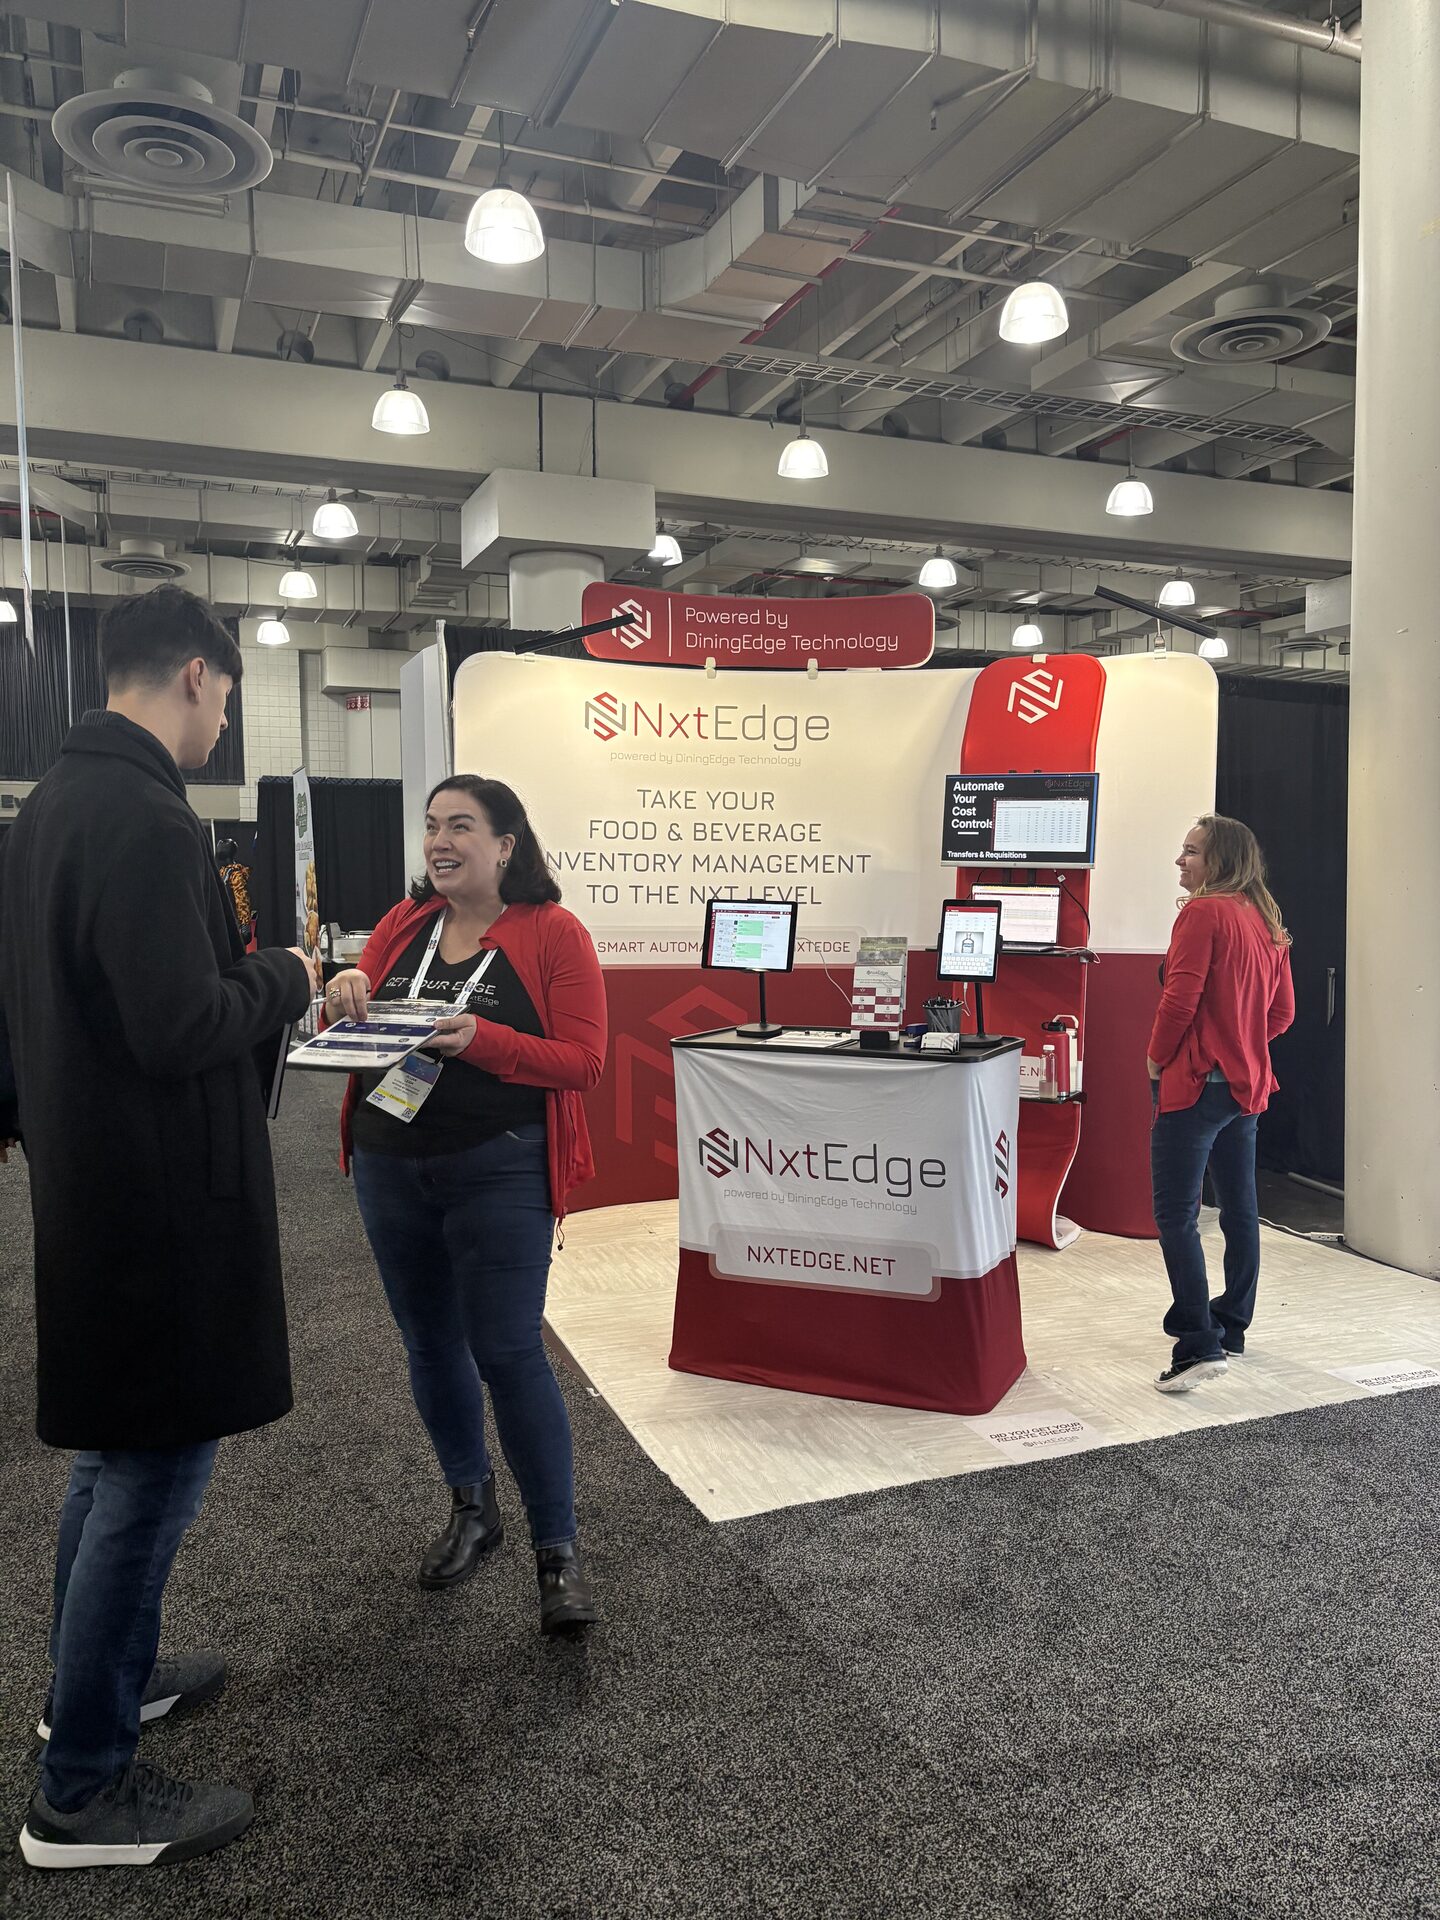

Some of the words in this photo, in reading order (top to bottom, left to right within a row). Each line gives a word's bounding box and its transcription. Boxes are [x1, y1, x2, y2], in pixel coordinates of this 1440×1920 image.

[685, 607, 760, 625] Powered
[766, 609, 788, 629] by
[686, 632, 786, 654] DiningEdge
[791, 634, 899, 652] Technology
[633, 701, 830, 751] NxtEdge
[610, 752, 656, 763] powered
[659, 752, 673, 765] by
[675, 753, 736, 766] DiningEdge
[739, 754, 802, 767] Technology
[953, 781, 1005, 791] Automate
[636, 789, 697, 810] TAKE
[706, 791, 775, 811] YOUR
[952, 793, 977, 804] Your
[951, 806, 977, 816] Cost
[589, 820, 658, 841] FOOD
[667, 822, 683, 842] &
[693, 822, 822, 842] BEVERAGE
[546, 851, 683, 873] NVENTORY
[692, 854, 871, 874] MANAGEMENT
[947, 850, 978, 858] Transfers
[985, 851, 1027, 860] Requisitions
[586, 884, 618, 904] TO
[628, 885, 679, 905] THE
[690, 886, 739, 905] NXT
[597, 941, 645, 953] SMART
[797, 941, 851, 953] XTEDGE
[386, 976, 409, 987] GET
[451, 980, 497, 996] EGE
[745, 1136, 946, 1198] NxtEdge
[723, 1188, 769, 1200] powered
[771, 1190, 785, 1204] by
[787, 1192, 848, 1209] DiningEdge
[850, 1197, 917, 1215] Technology
[747, 1245, 896, 1276] NXTEDGE.NET
[996, 1433, 1039, 1443] REBATE
[1038, 1425, 1084, 1437] CHECKS?
[1031, 1425, 1051, 1433] GET
[1052, 1421, 1081, 1430] YOUR
